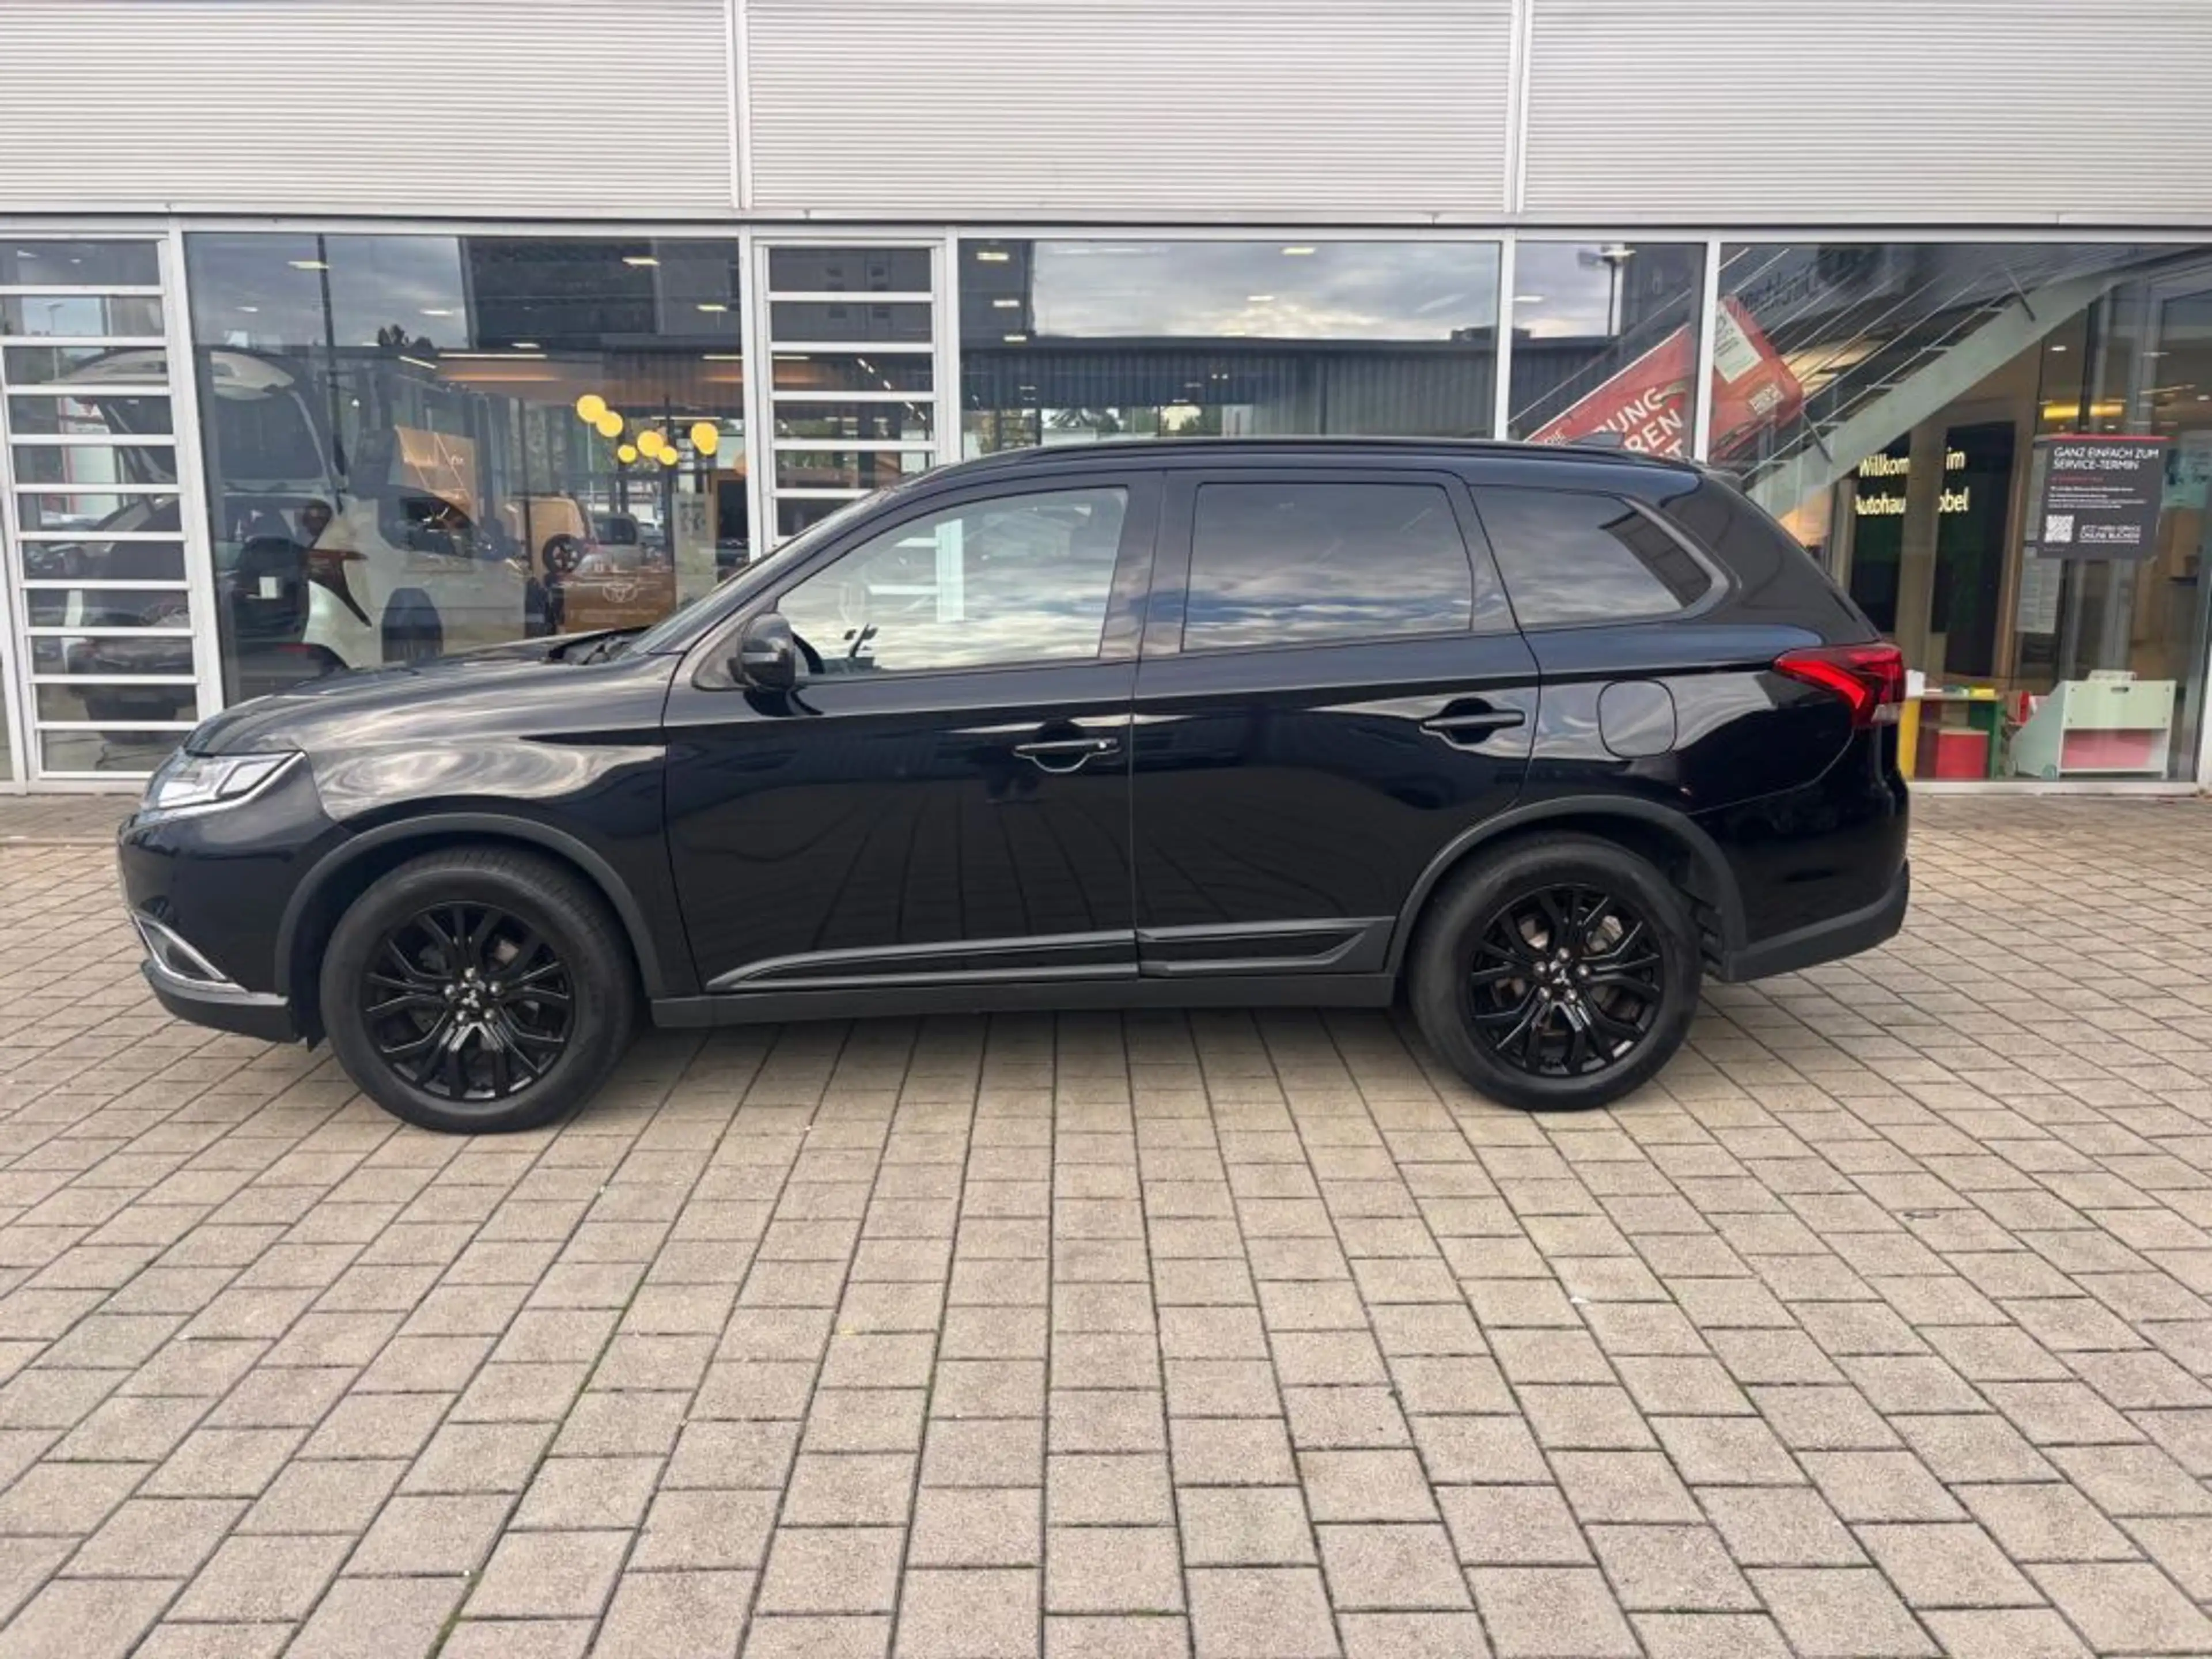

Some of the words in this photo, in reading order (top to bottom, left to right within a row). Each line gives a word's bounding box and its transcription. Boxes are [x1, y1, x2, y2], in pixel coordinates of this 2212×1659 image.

[1592, 387, 1663, 432] UNG
[2052, 460, 2139, 470] SERVICE-TERMIN
[2054, 446, 2085, 458] GANZ
[2086, 447, 2133, 459] EINFACH
[2135, 448, 2159, 459] ZUM
[1859, 453, 1910, 478] Willkom
[1855, 491, 1907, 515] utohau
[1937, 486, 1969, 513] obel
